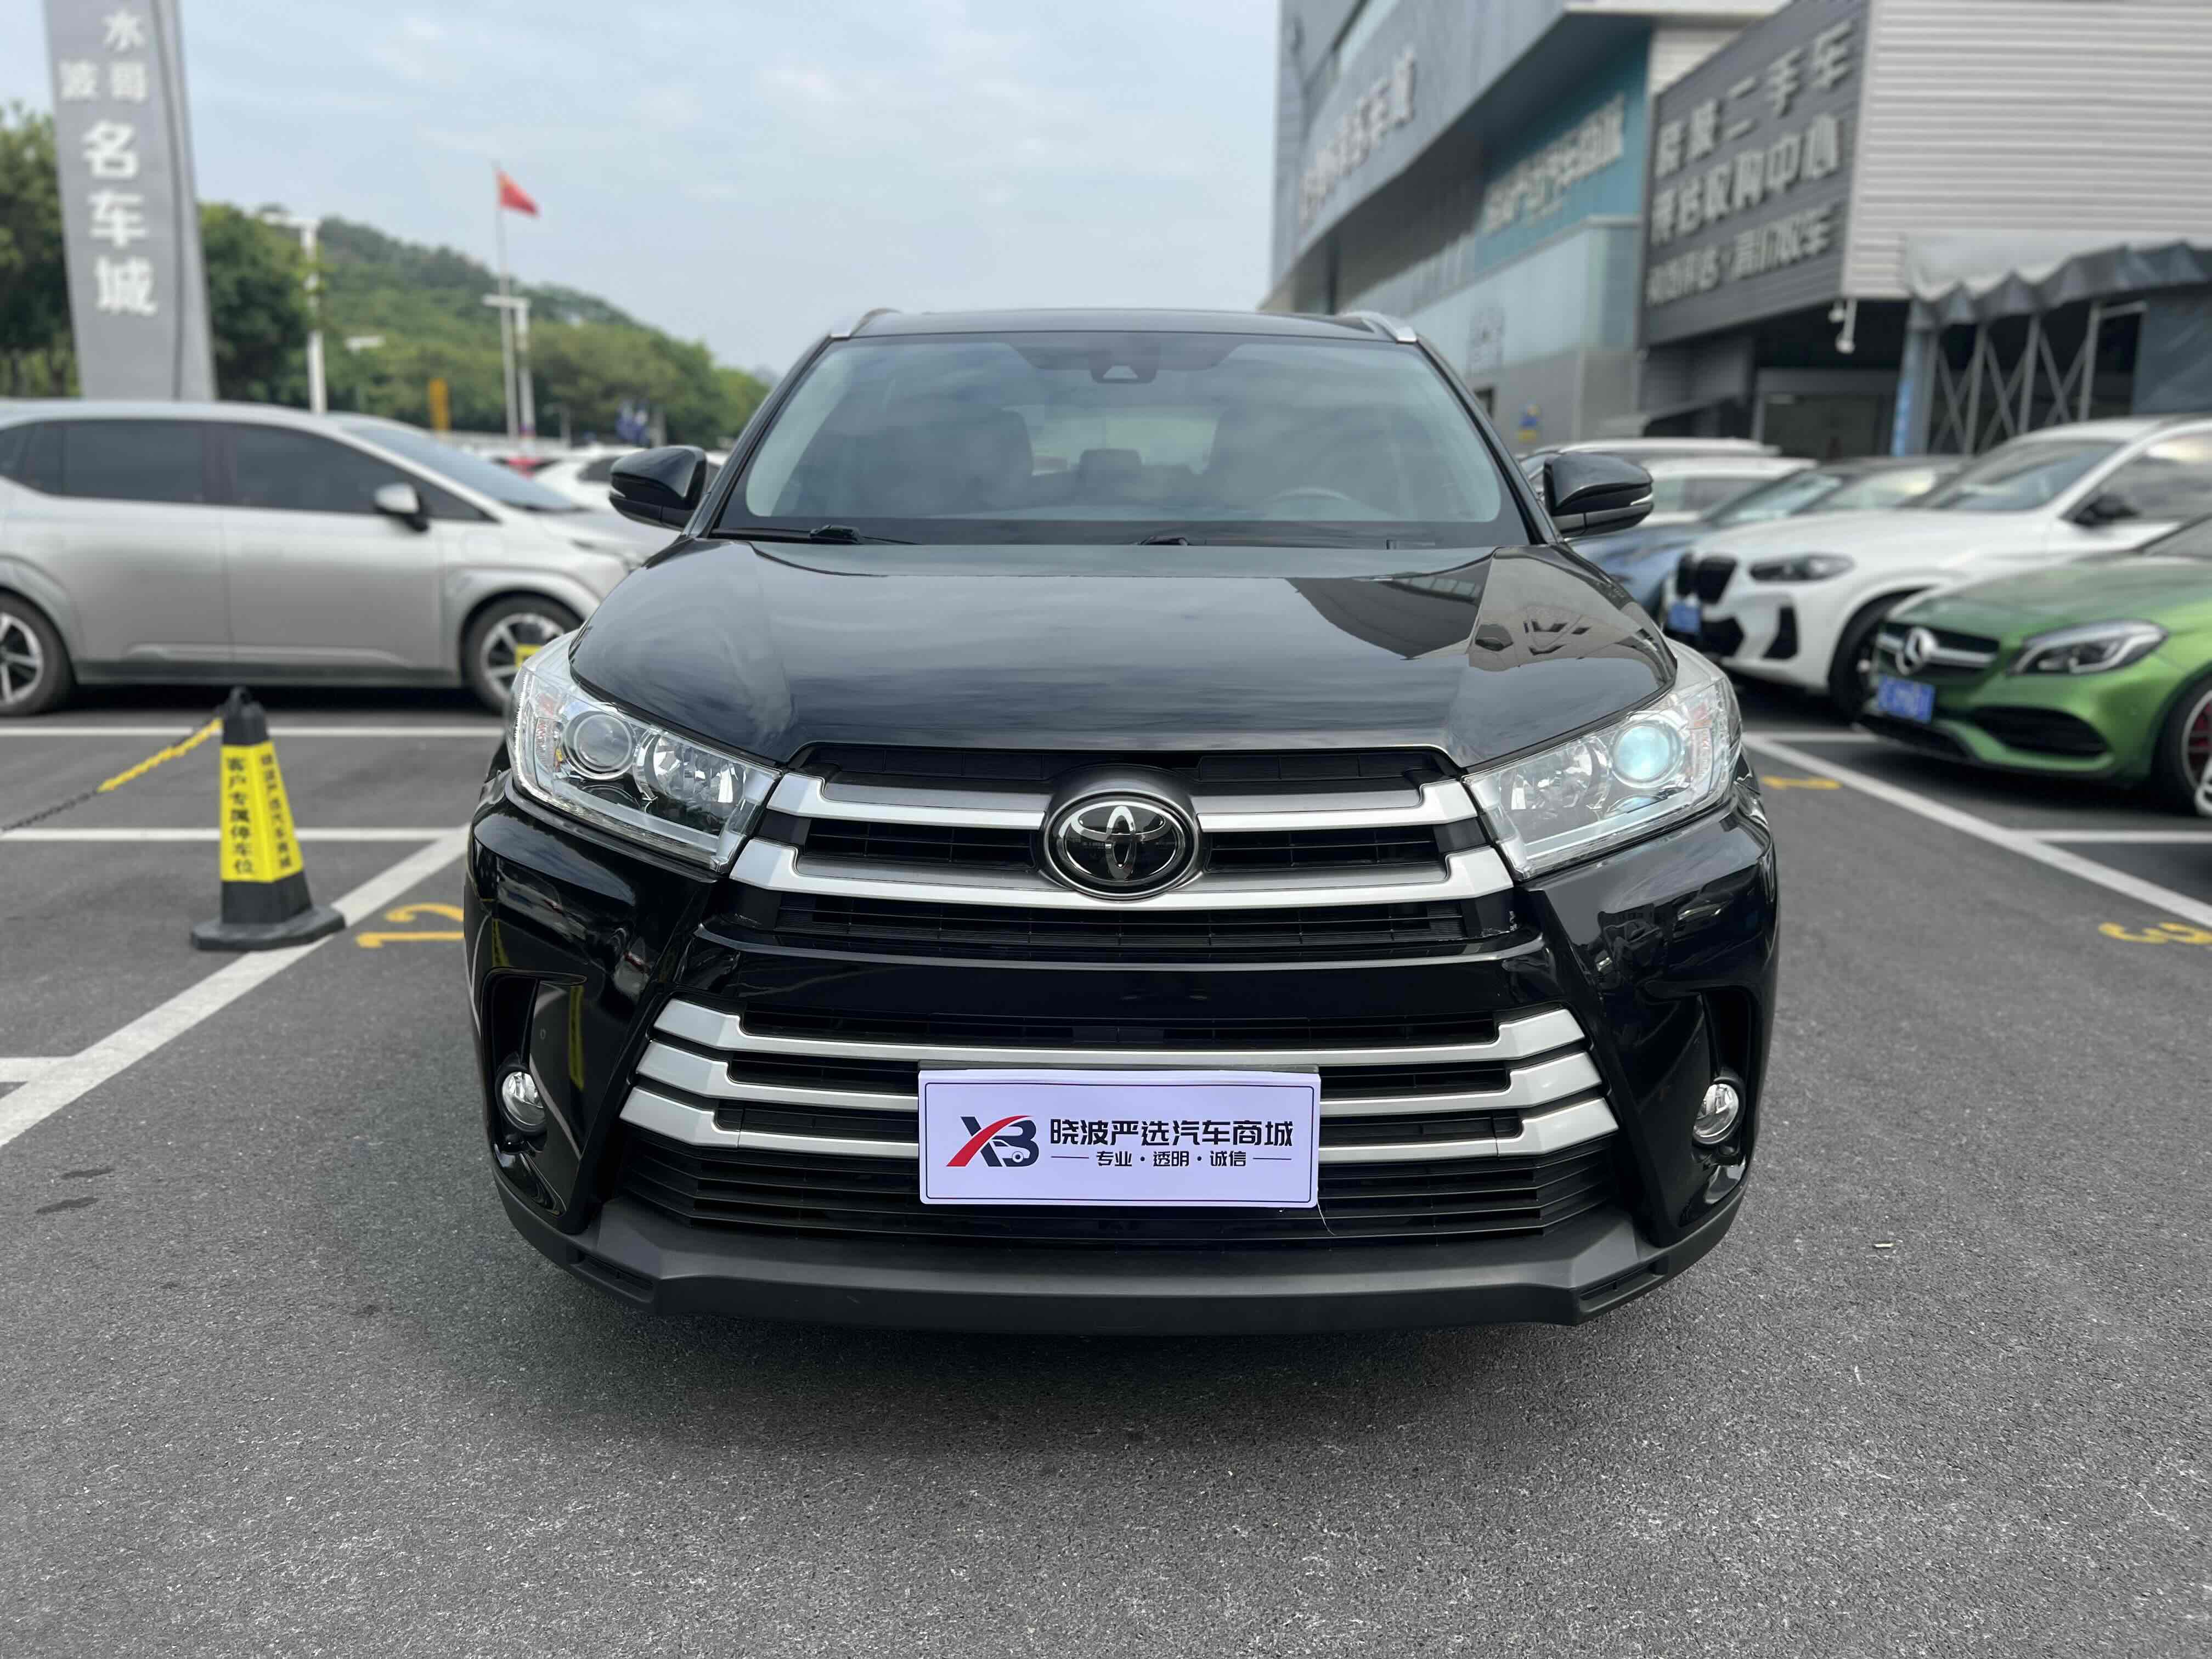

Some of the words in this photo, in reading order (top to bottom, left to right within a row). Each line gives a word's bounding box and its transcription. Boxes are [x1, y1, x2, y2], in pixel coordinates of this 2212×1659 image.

[227, 757, 254, 873] 客户专属停车位
[1050, 1119, 1294, 1147] 晓波严选汽车商城
